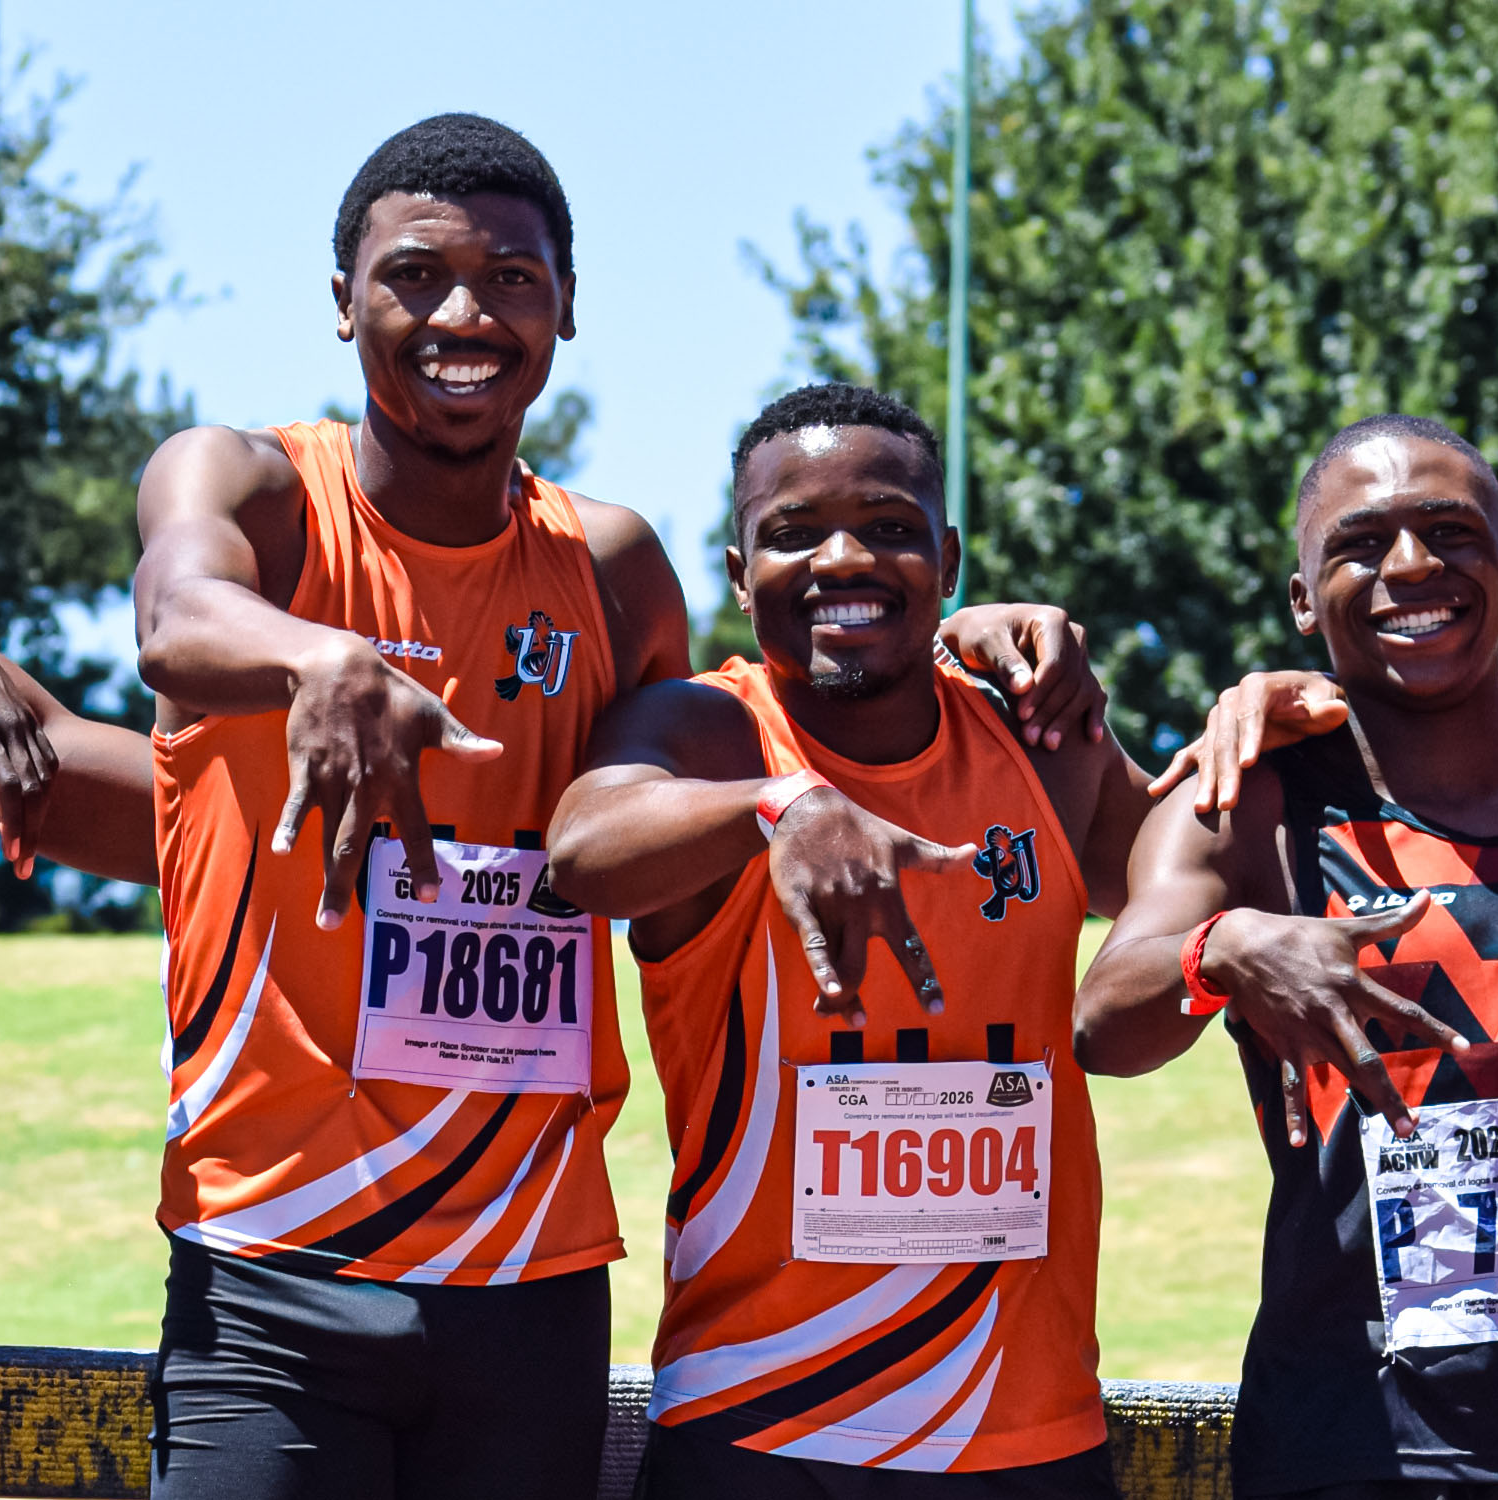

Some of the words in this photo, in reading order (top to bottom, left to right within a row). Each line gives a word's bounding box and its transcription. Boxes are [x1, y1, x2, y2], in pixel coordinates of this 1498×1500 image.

[461, 868, 521, 906] 2025
[376, 908, 414, 923] Covering
[426, 916, 459, 926] removal
[404, 1038, 429, 1049] Image
[430, 1041, 439, 1049] of
[460, 1043, 490, 1054] Sponsor
[460, 1053, 468, 1061] to
[469, 1053, 485, 1062] ASA
[826, 1074, 850, 1084] ASA
[993, 1075, 1027, 1092] ASA
[838, 1094, 868, 1106] CGA
[812, 1125, 1039, 1198] T16904
[1379, 1149, 1440, 1174] ACNW
[1376, 1183, 1412, 1195] Covering
[1488, 1306, 1497, 1314] to
